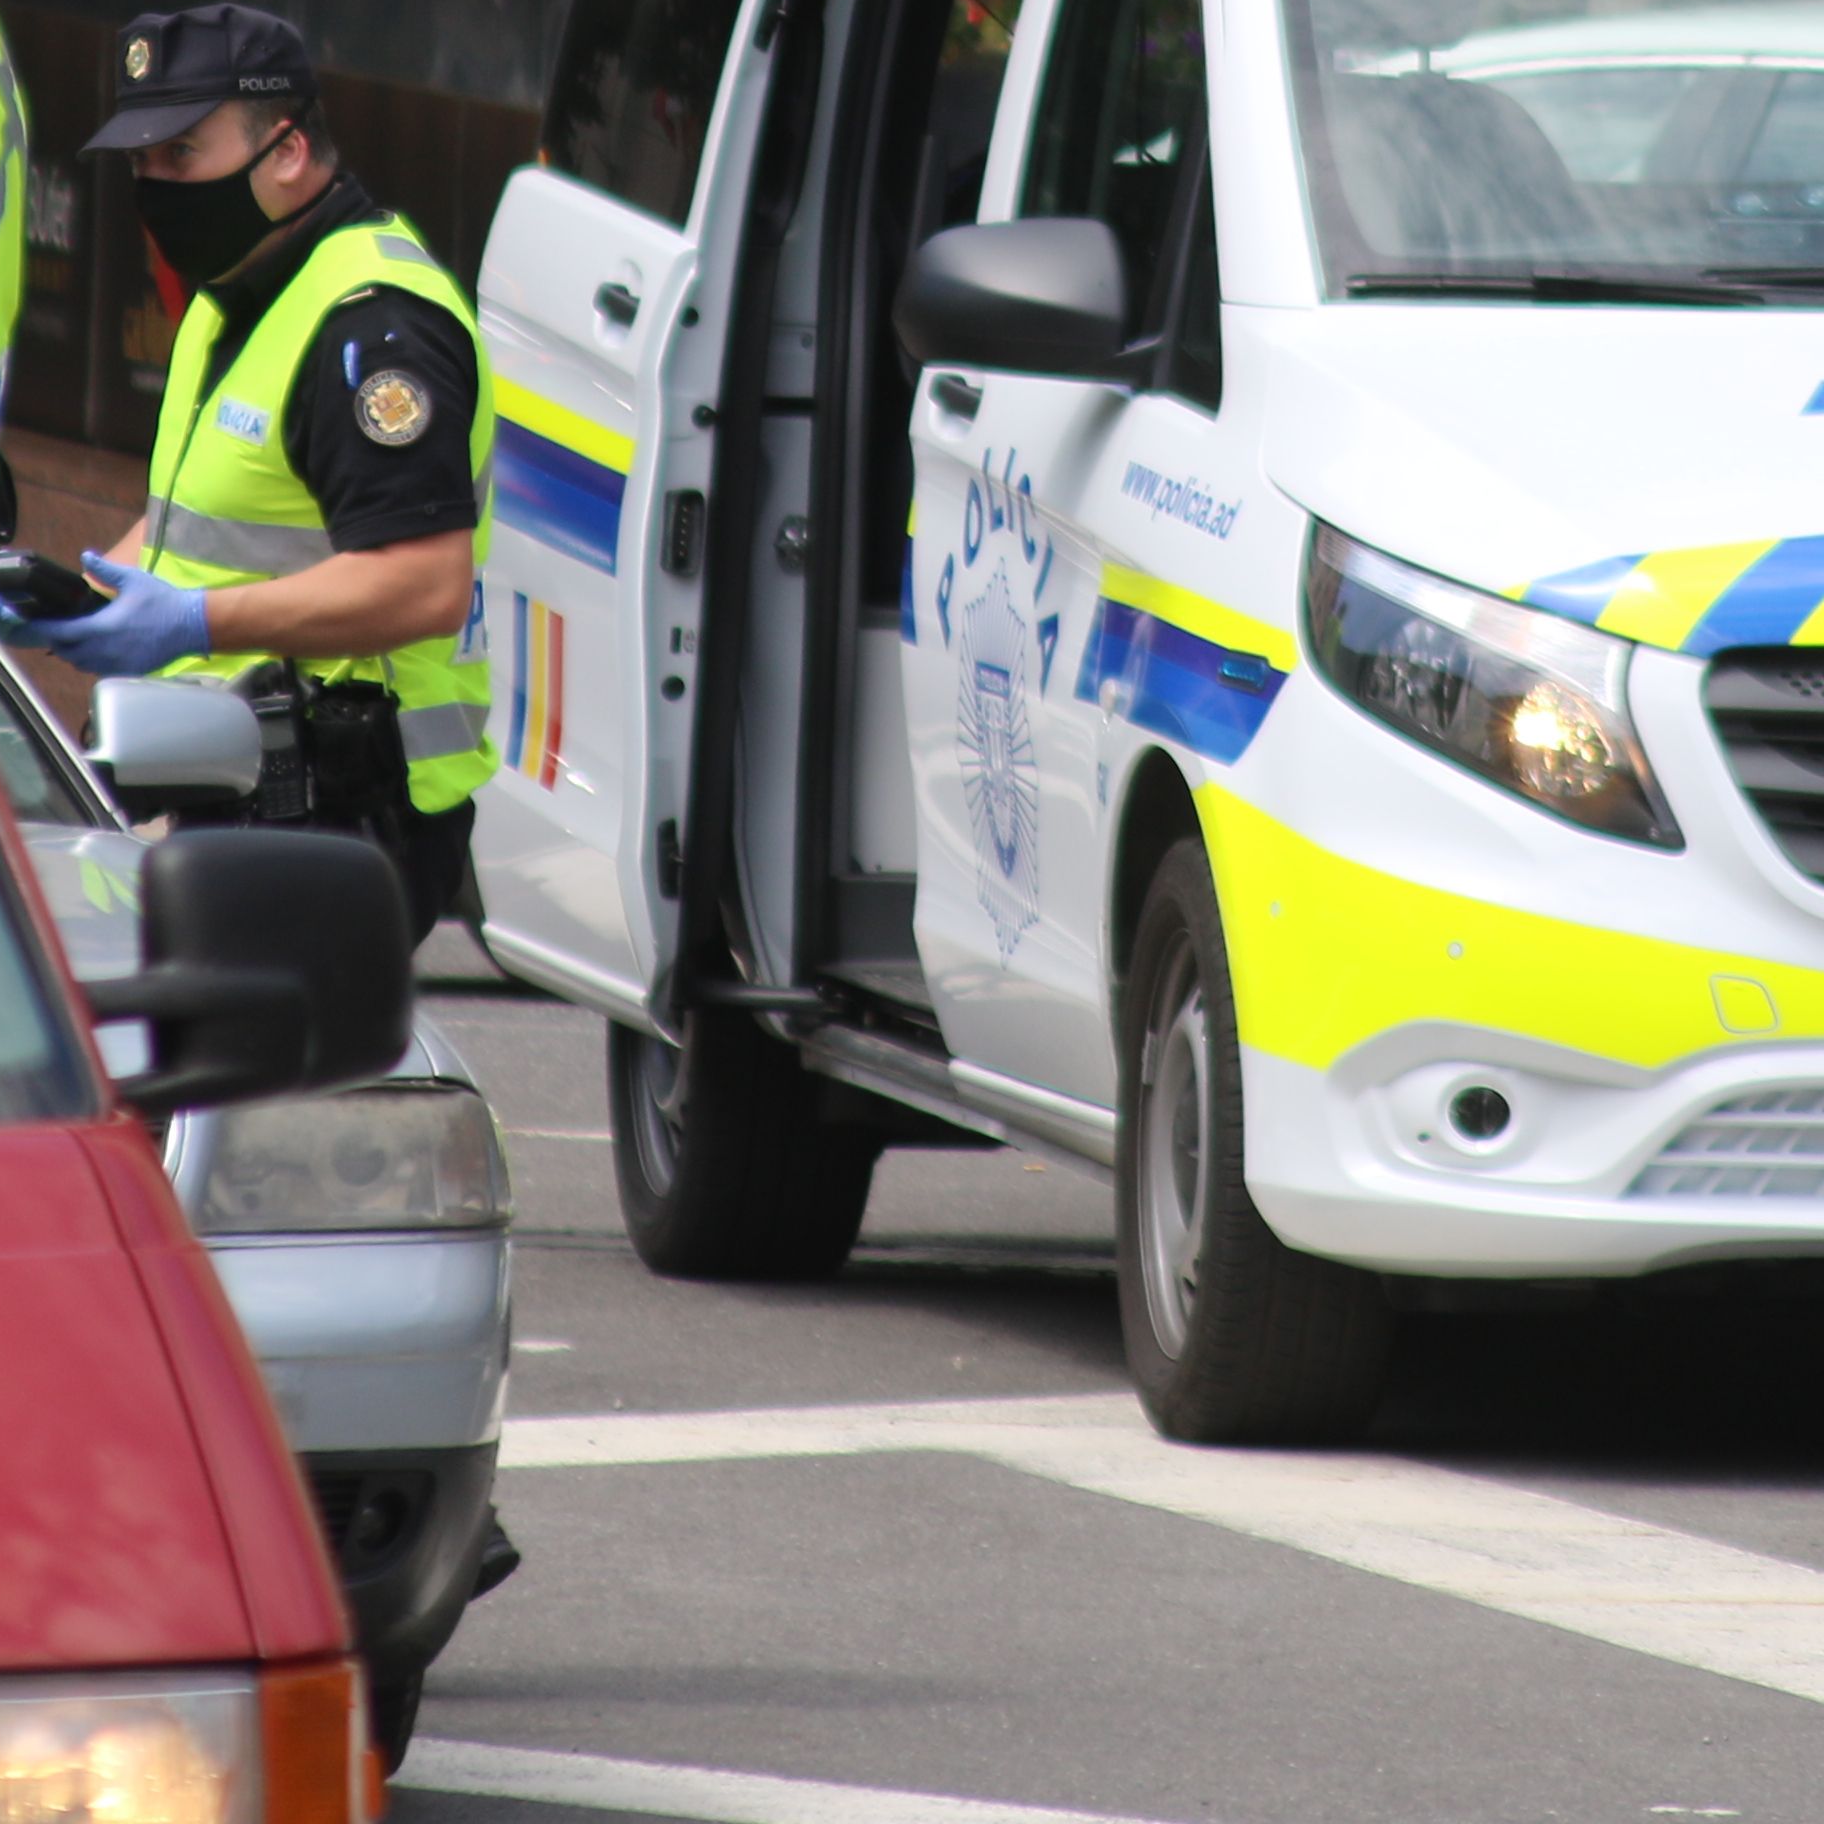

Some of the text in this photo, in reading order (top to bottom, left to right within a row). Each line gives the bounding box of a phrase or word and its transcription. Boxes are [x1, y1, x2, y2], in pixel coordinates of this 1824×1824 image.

[239, 75, 292, 92] POLICIA
[1120, 460, 1243, 540] www.policia.ad
[935, 447, 1061, 701] POLICIA
